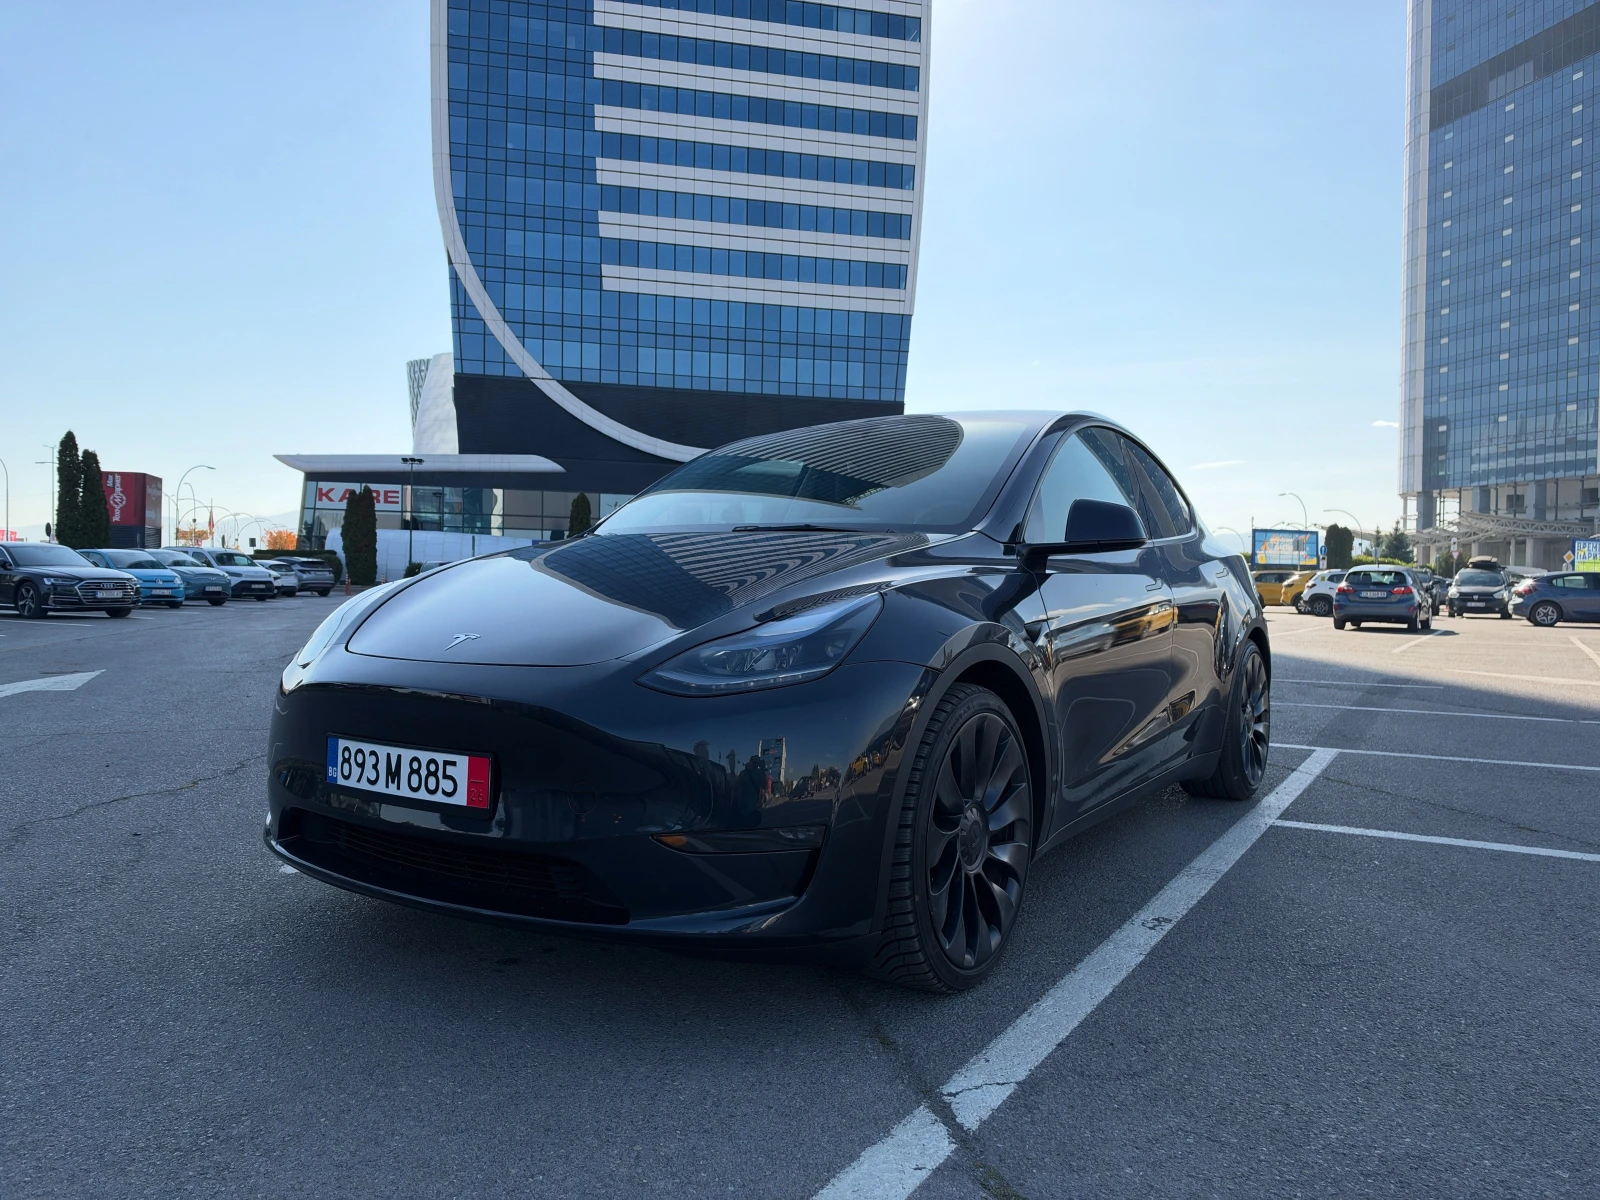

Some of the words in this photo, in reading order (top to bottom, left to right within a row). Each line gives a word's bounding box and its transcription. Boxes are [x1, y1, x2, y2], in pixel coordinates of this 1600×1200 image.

[328, 766, 337, 777] BG
[340, 745, 380, 786] 893
[385, 752, 402, 790] M
[407, 756, 458, 798] 885
[470, 788, 483, 802] 26
